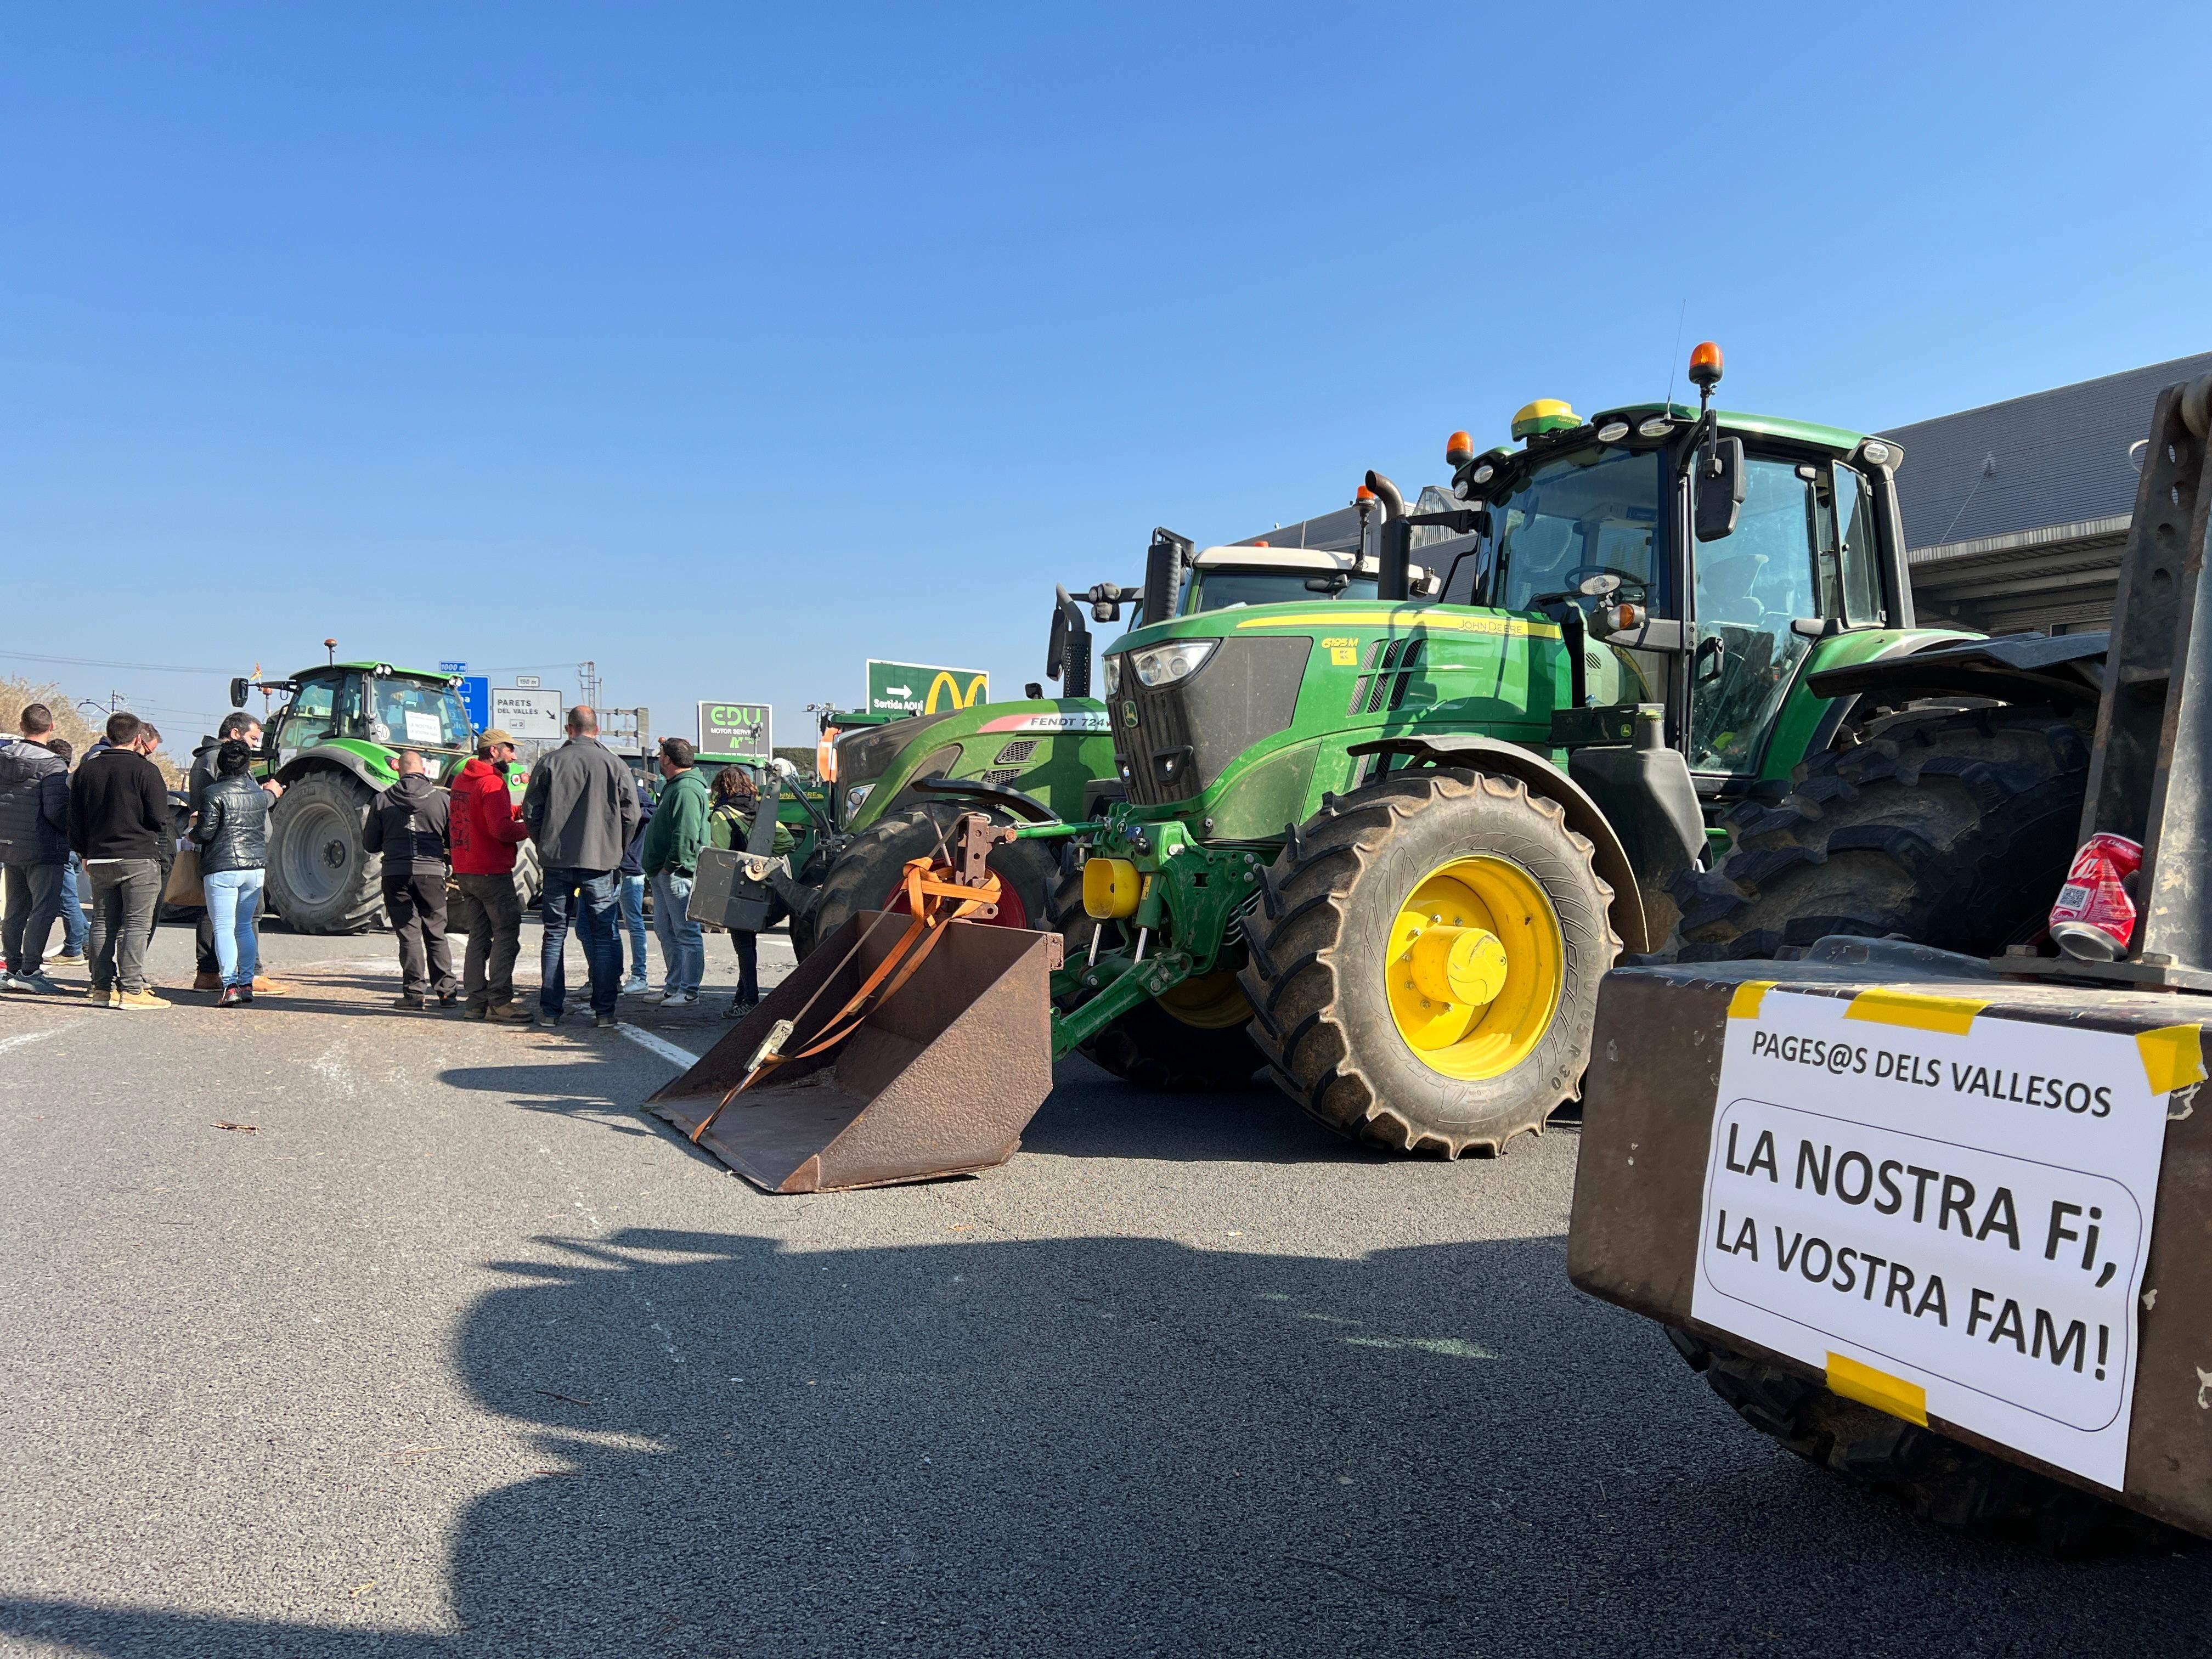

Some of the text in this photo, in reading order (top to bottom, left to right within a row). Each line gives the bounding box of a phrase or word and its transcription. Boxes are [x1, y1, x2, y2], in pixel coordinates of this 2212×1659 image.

[1458, 618, 1523, 634] JOHN DEERE
[1321, 636, 1359, 648] 6195M
[873, 698, 903, 710] Sortida
[710, 706, 761, 726] EDU
[1030, 718, 1076, 726] FENDT
[1081, 718, 1104, 726] 724
[376, 725, 387, 738] 50
[1752, 1031, 2111, 1118] PAGES@S DELS VALLESOS
[1726, 1122, 2117, 1288] LA NOSTRA Fi,
[1716, 1209, 2109, 1381] LA VOSTRA FAM!
